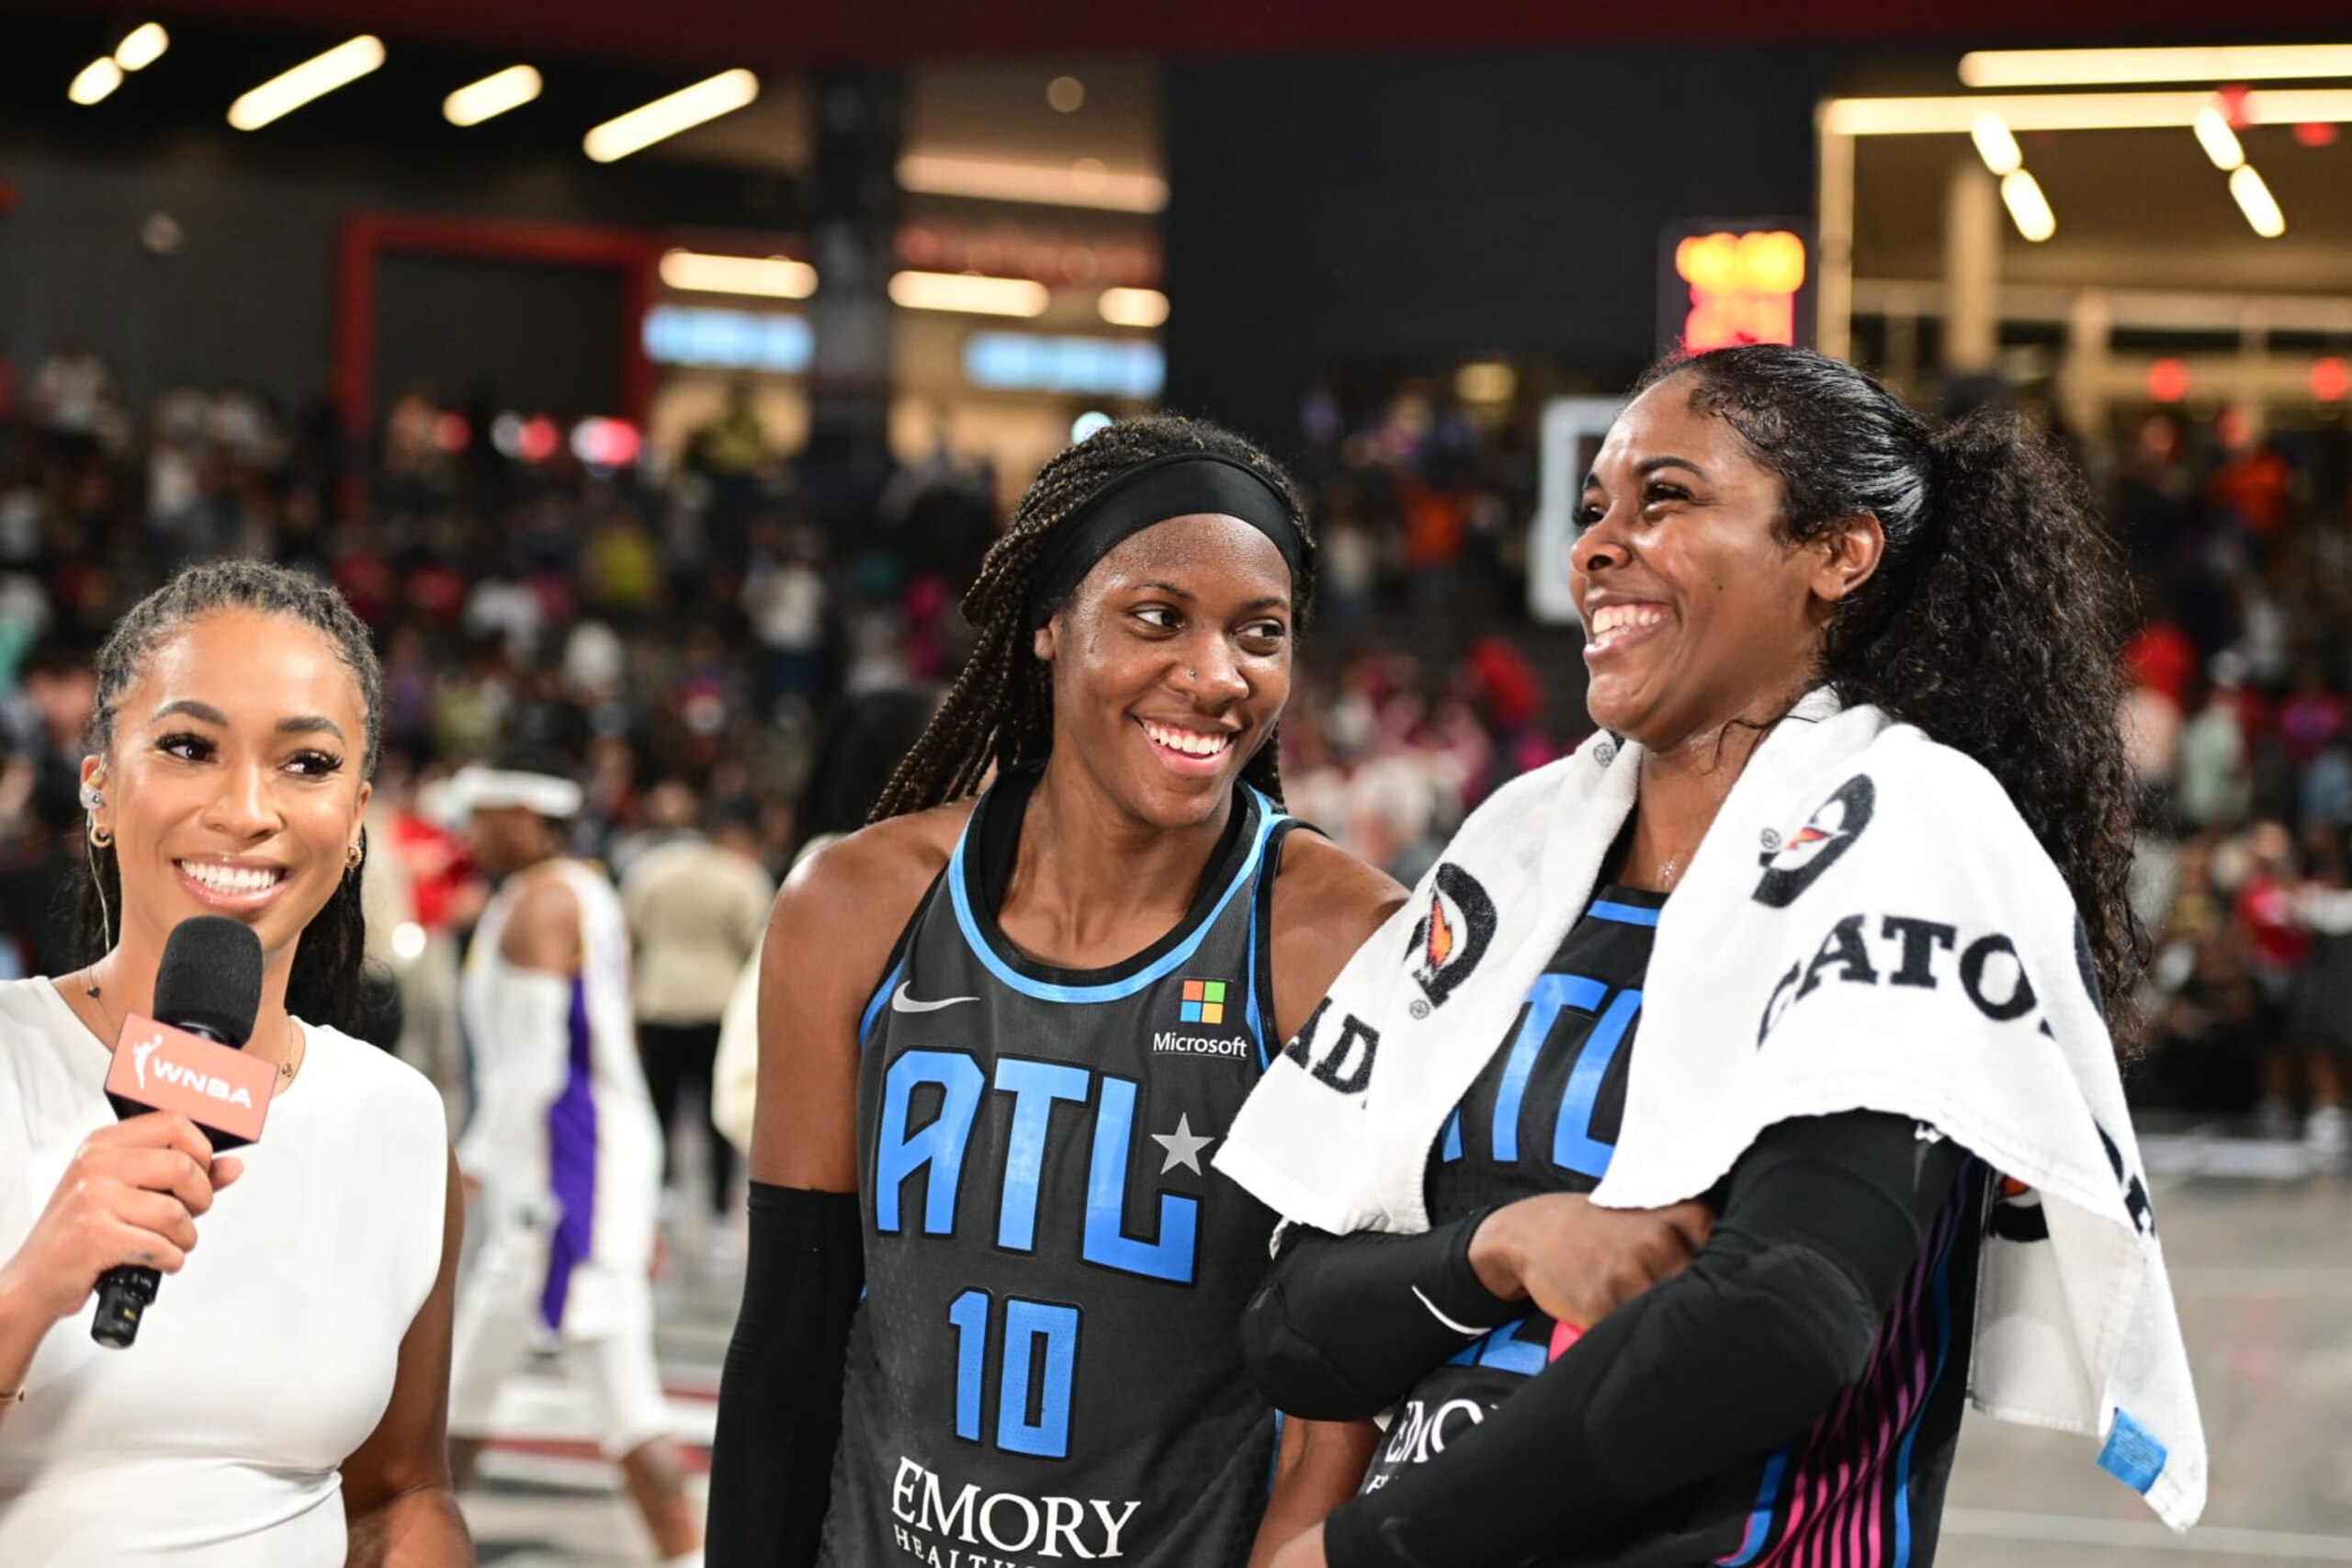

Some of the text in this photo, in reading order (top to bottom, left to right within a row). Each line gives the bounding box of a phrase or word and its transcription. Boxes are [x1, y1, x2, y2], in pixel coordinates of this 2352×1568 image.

[153, 1057, 252, 1109] WNBA
[1153, 1032, 1248, 1058] Microsoft
[875, 1048, 1199, 1284] ATL
[947, 1288, 1080, 1461] 10
[891, 1456, 1142, 1559] EMORY
